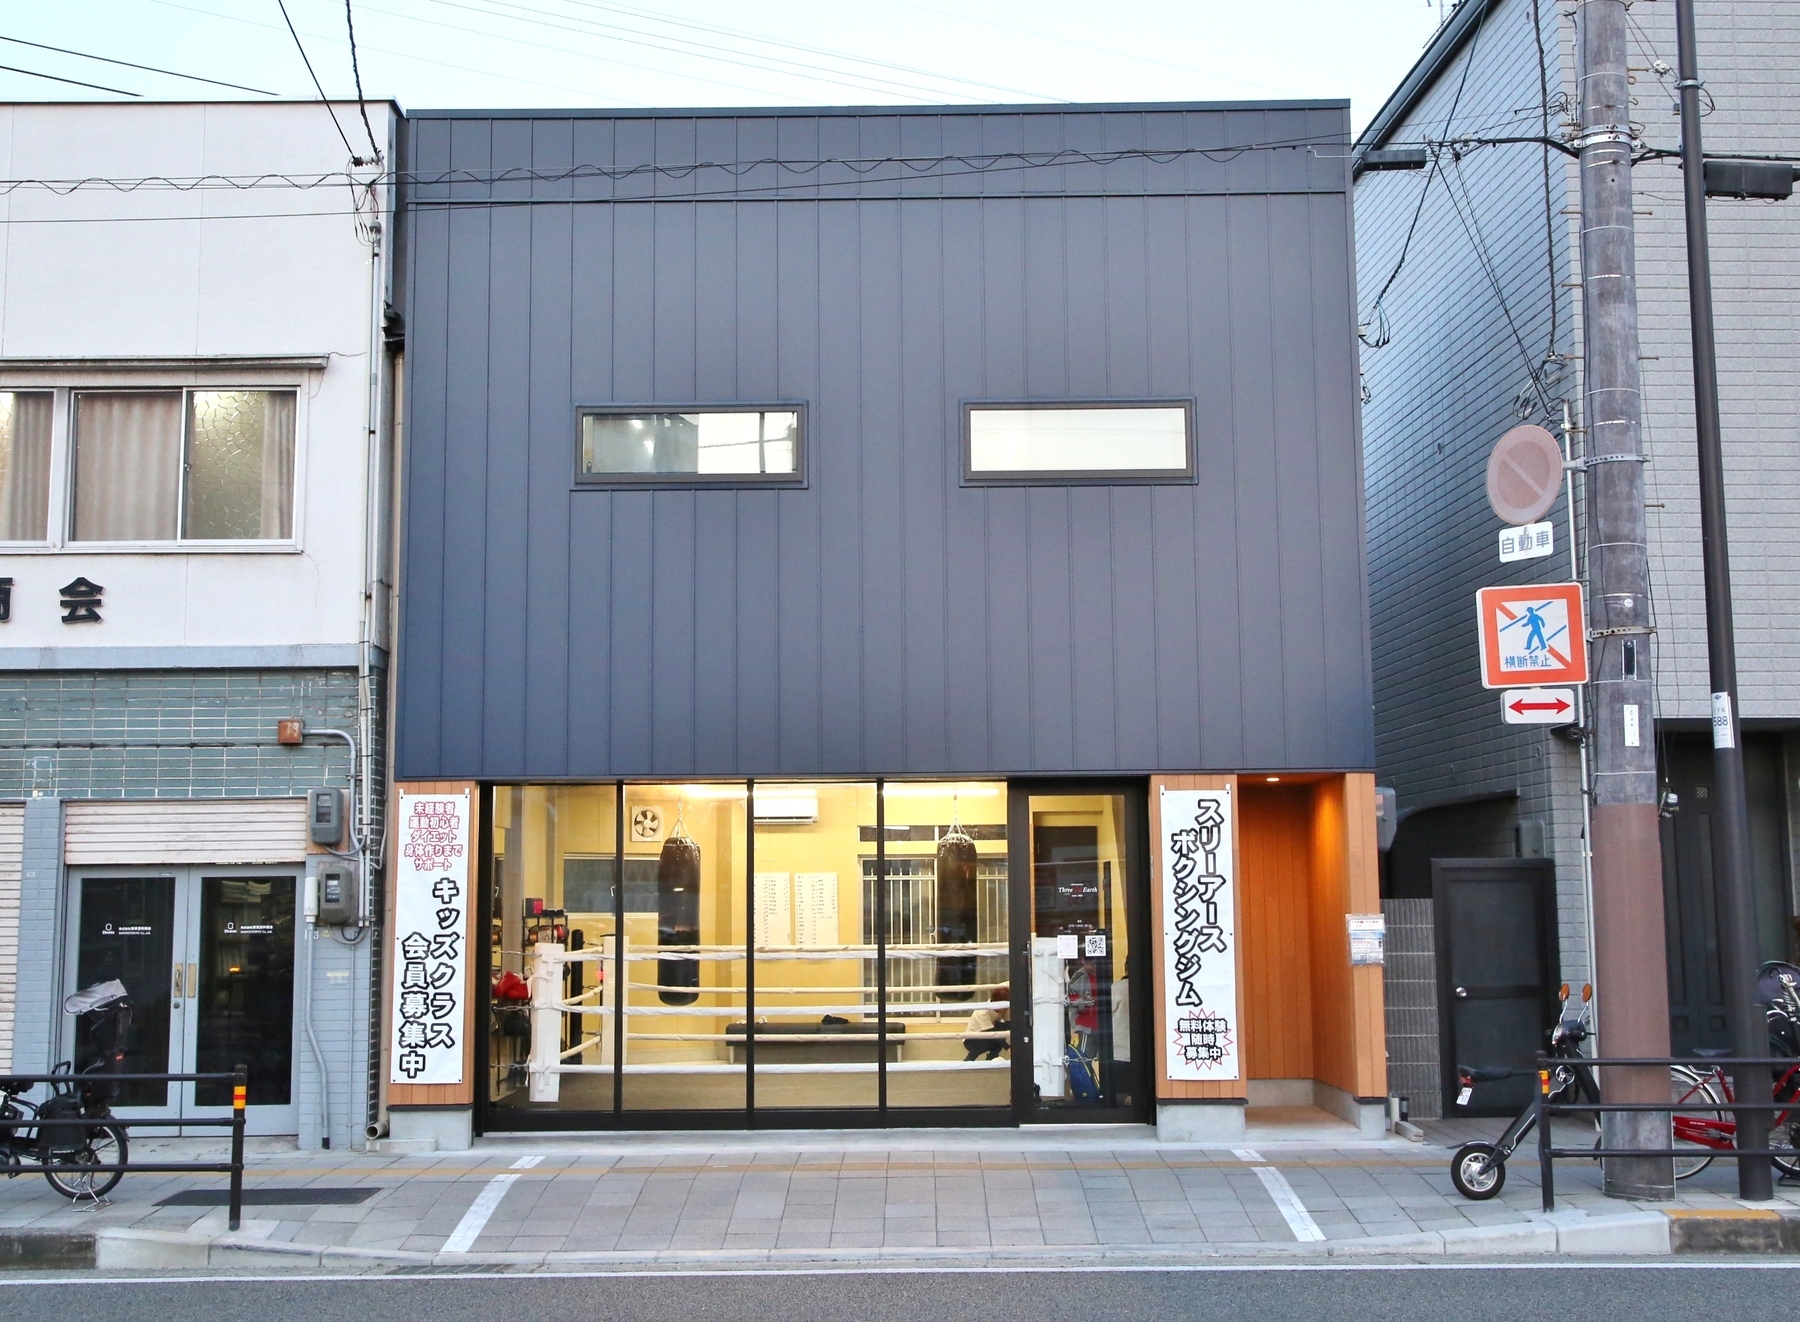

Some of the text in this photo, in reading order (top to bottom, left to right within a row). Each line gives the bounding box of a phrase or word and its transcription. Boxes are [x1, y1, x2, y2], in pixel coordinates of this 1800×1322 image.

[1501, 530, 1550, 555] 自動車
[1505, 655, 1552, 668] 横断禁止
[414, 801, 455, 816] 未経験者
[408, 815, 460, 830] 運動初心者
[411, 829, 457, 844] ダイエット
[404, 843, 463, 858] 身体作りまで
[414, 858, 452, 872] サポート
[1195, 799, 1227, 953] スリーアース
[1171, 827, 1203, 1007] ボクシングジム
[427, 877, 460, 1049] キッズクラス
[399, 931, 431, 1079] 会員募集中
[1177, 1018, 1228, 1033] 無料体験
[1184, 1045, 1222, 1061] 募集中
